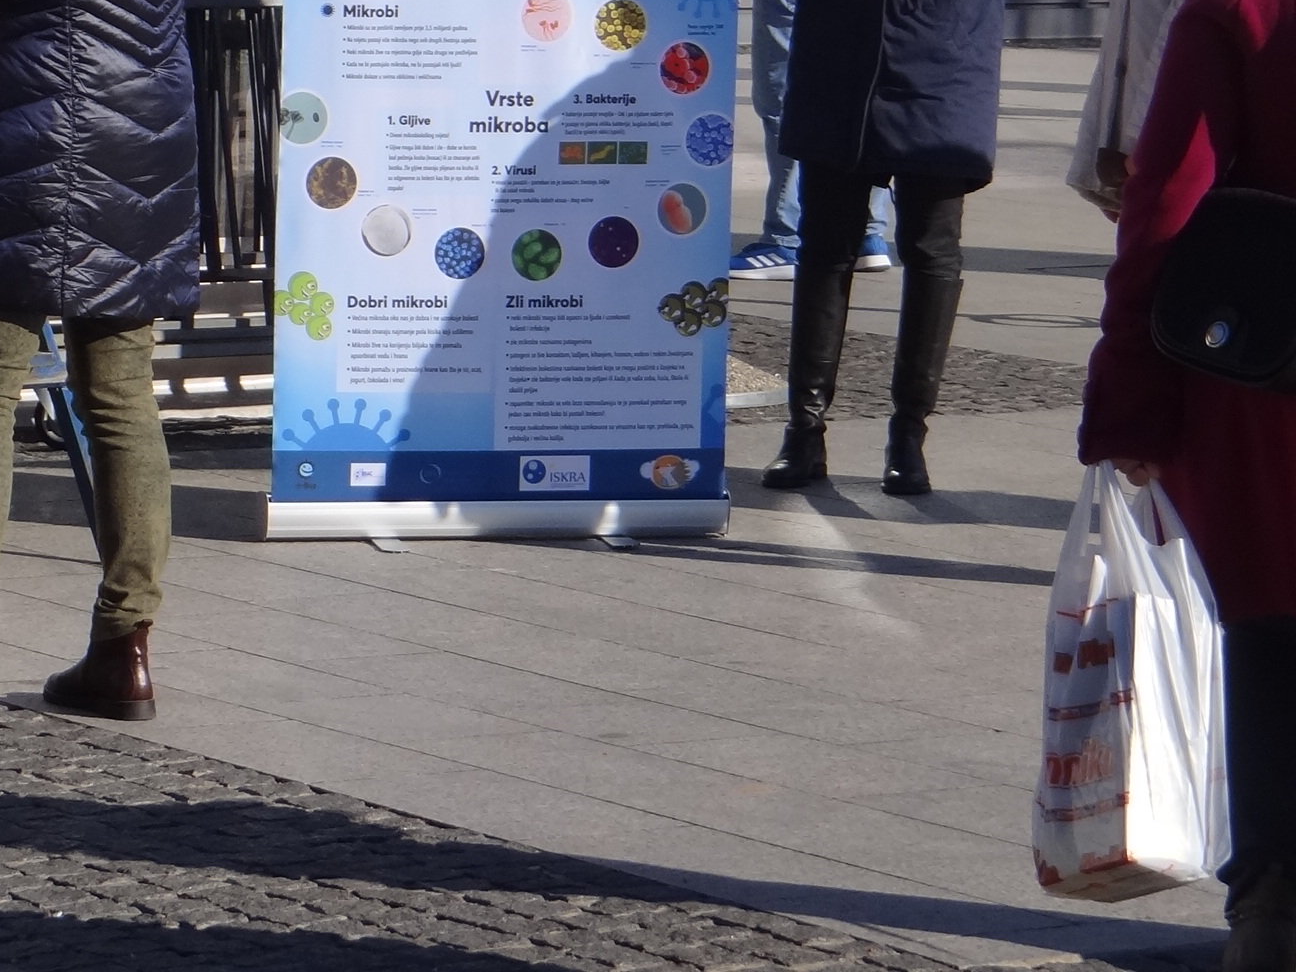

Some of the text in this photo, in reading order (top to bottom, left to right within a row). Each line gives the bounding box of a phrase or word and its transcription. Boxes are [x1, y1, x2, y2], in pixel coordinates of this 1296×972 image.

[343, 4, 399, 18] Mikrobi
[486, 90, 534, 107] Vrste
[573, 94, 636, 106] 3. Bakterije
[387, 115, 431, 128] 1. Gljive
[469, 116, 549, 133] mikroba
[492, 165, 537, 176] 2. Virusi
[347, 295, 448, 308] Dobri mikrobi
[505, 295, 583, 308] Zli mikrobi
[549, 471, 586, 483] ISKRA
